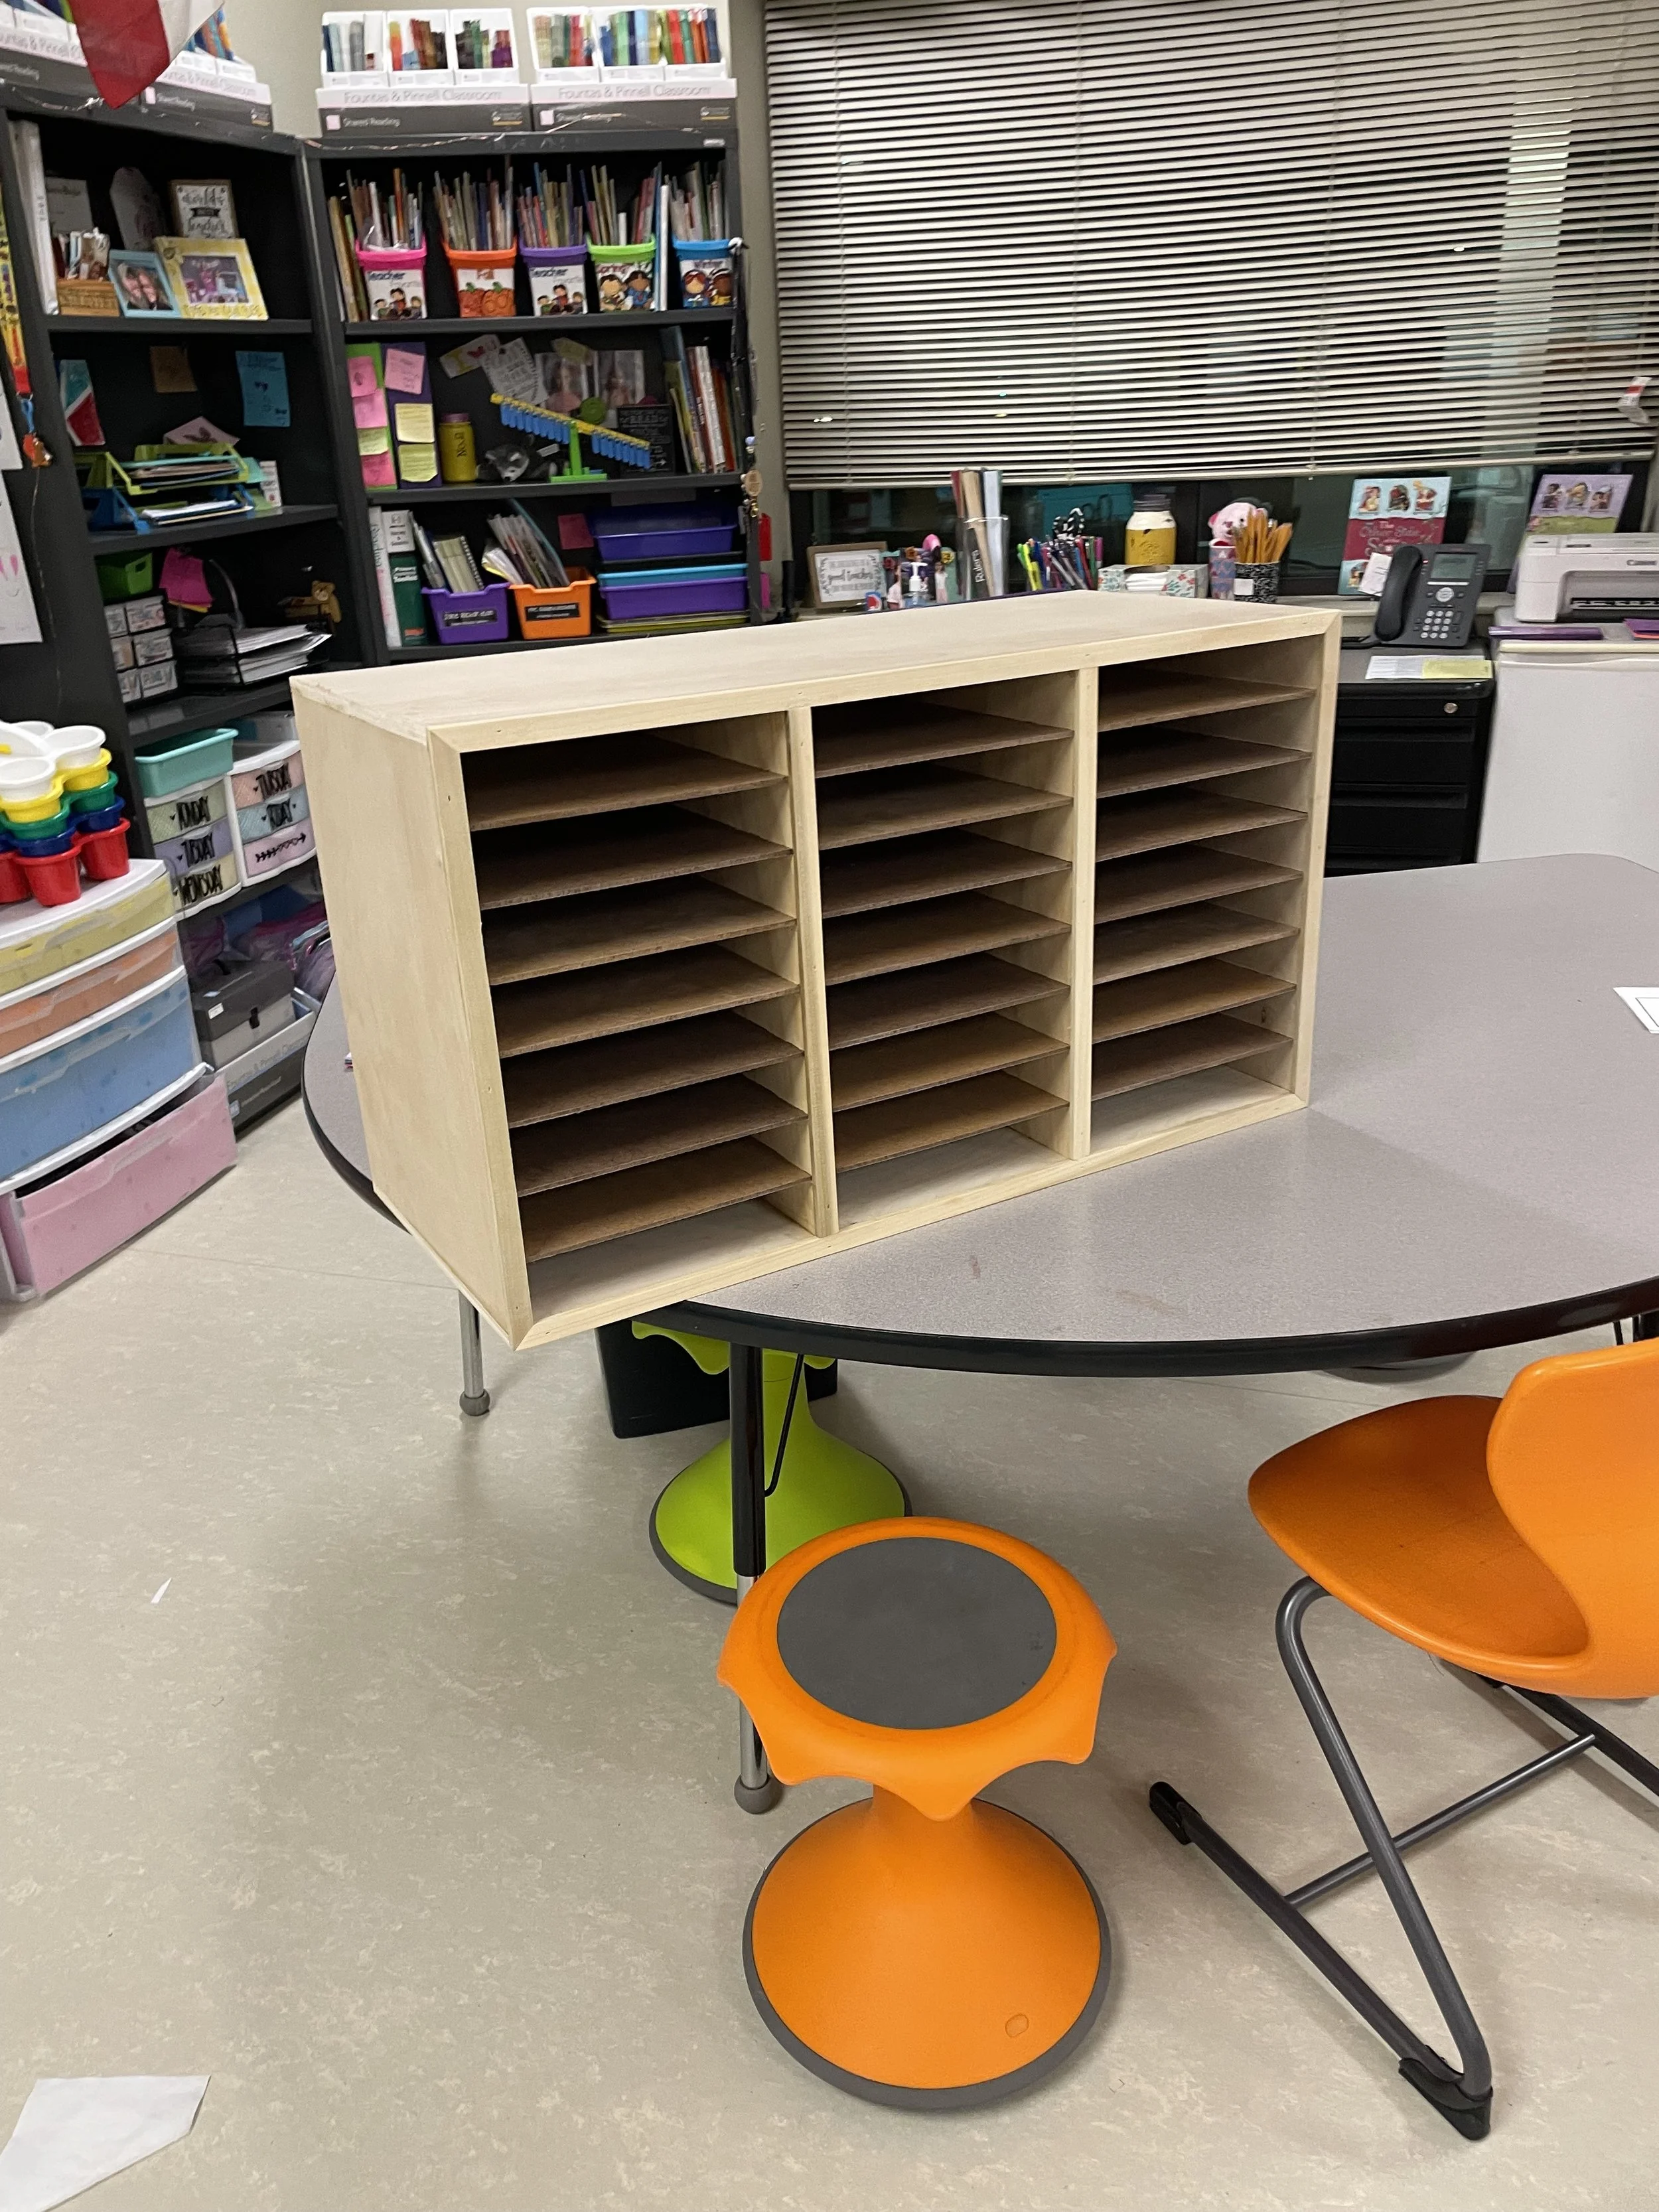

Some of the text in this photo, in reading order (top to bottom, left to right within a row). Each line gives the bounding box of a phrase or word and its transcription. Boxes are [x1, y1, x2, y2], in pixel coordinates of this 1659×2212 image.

[443, 89, 502, 100] Classroom
[653, 84, 712, 96] Classroom
[971, 550, 985, 583] Rulers
